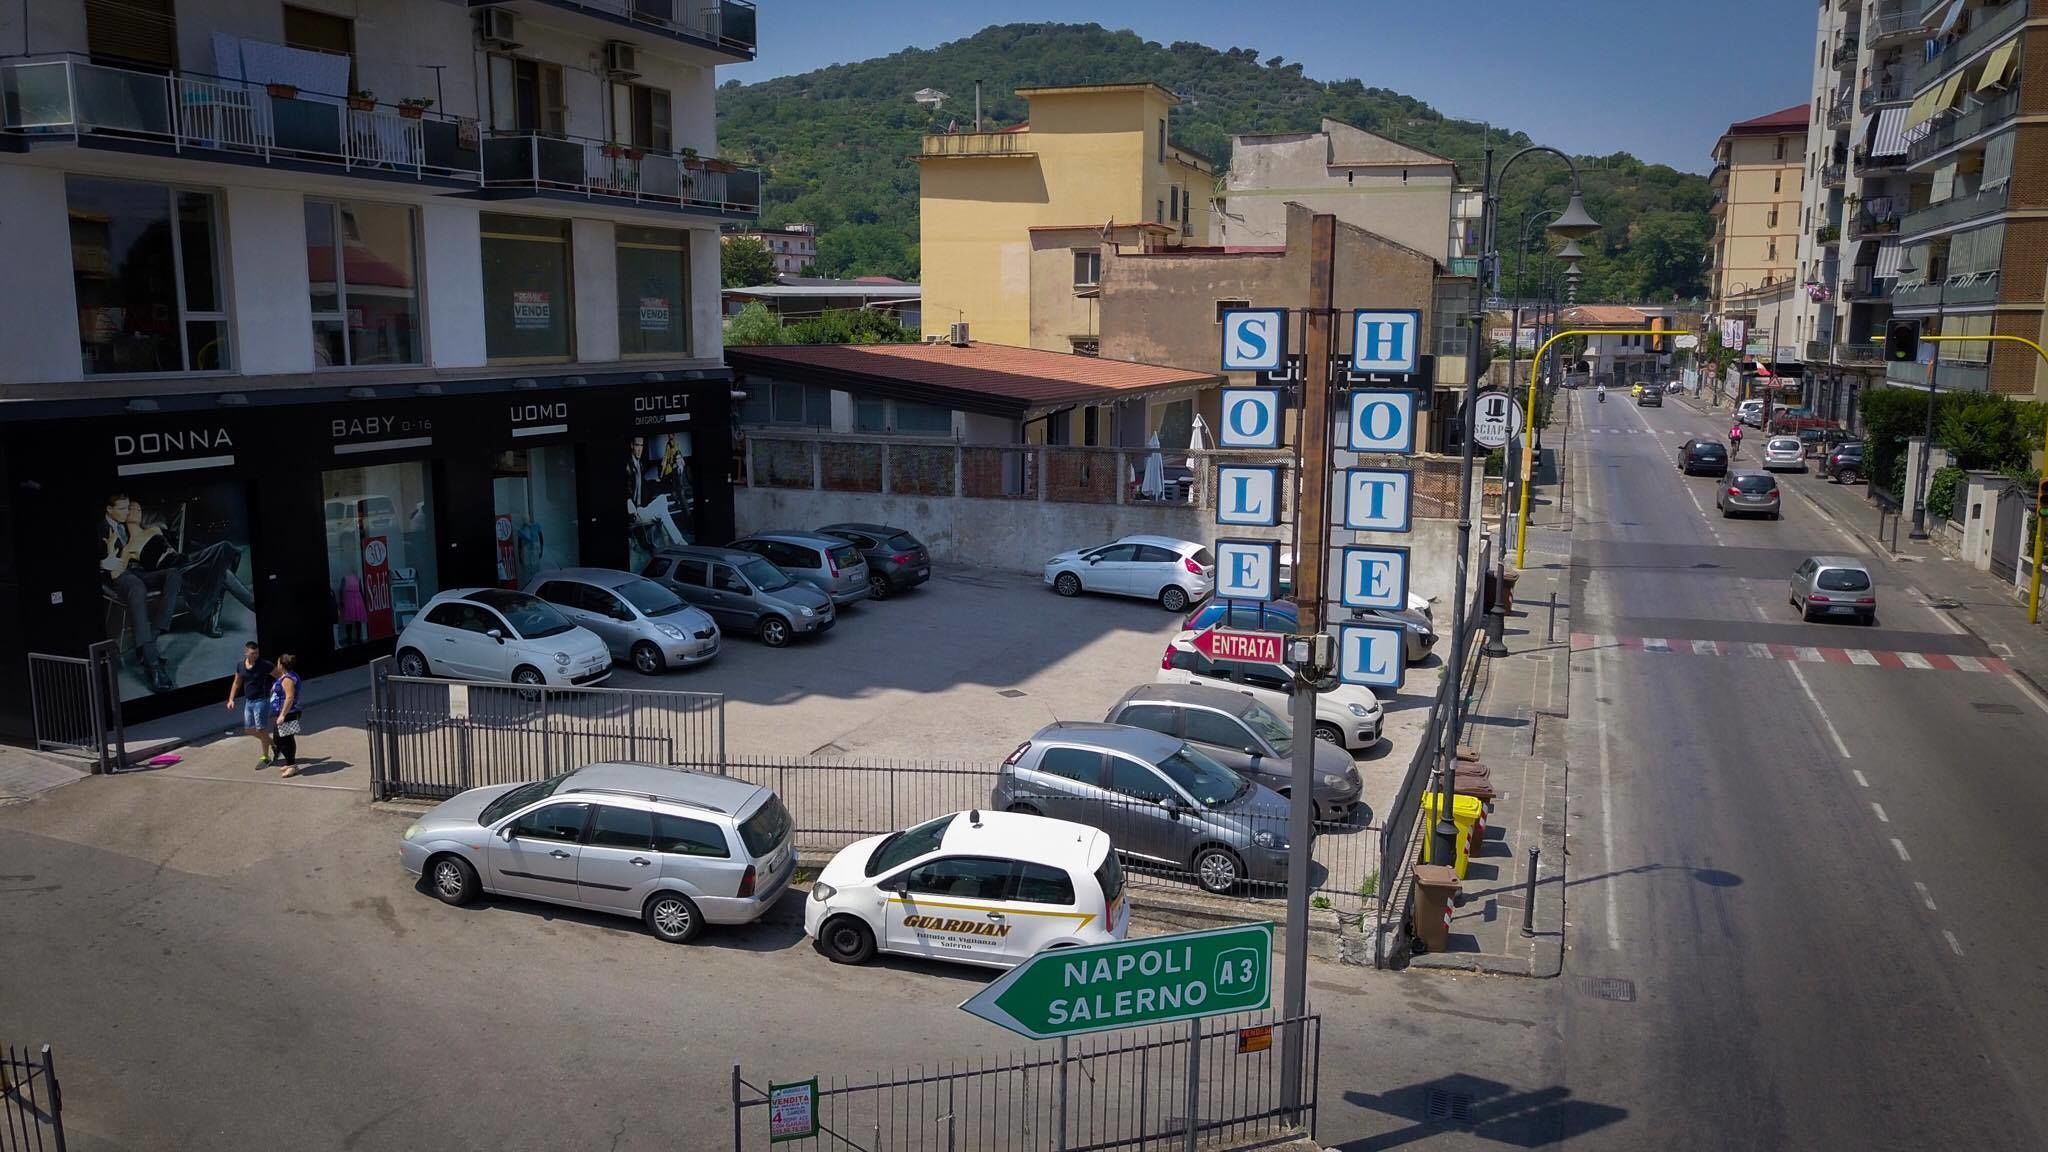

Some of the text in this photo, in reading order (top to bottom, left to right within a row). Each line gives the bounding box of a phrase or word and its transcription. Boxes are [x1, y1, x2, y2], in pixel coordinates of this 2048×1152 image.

[514, 305, 549, 317] VENDE
[640, 309, 669, 321] VENDE
[510, 403, 568, 422] UOMO
[634, 394, 690, 412] OUTLET
[332, 415, 395, 437] BABY
[1474, 423, 1505, 435] SCIAP
[115, 428, 233, 456] DONNA
[1354, 321, 1409, 675] HOTEL
[367, 570, 391, 612] Saldi
[1212, 635, 1275, 659] ENTRATA
[903, 915, 1012, 937] GUARDIAN
[941, 941, 972, 950] Salerno
[958, 937, 997, 946] Vigilanza
[1064, 946, 1192, 987] NAPOLI
[1048, 980, 1207, 1025] SALERNO
[772, 1095, 809, 1105] VENDITA
[773, 1111, 783, 1123] 4
